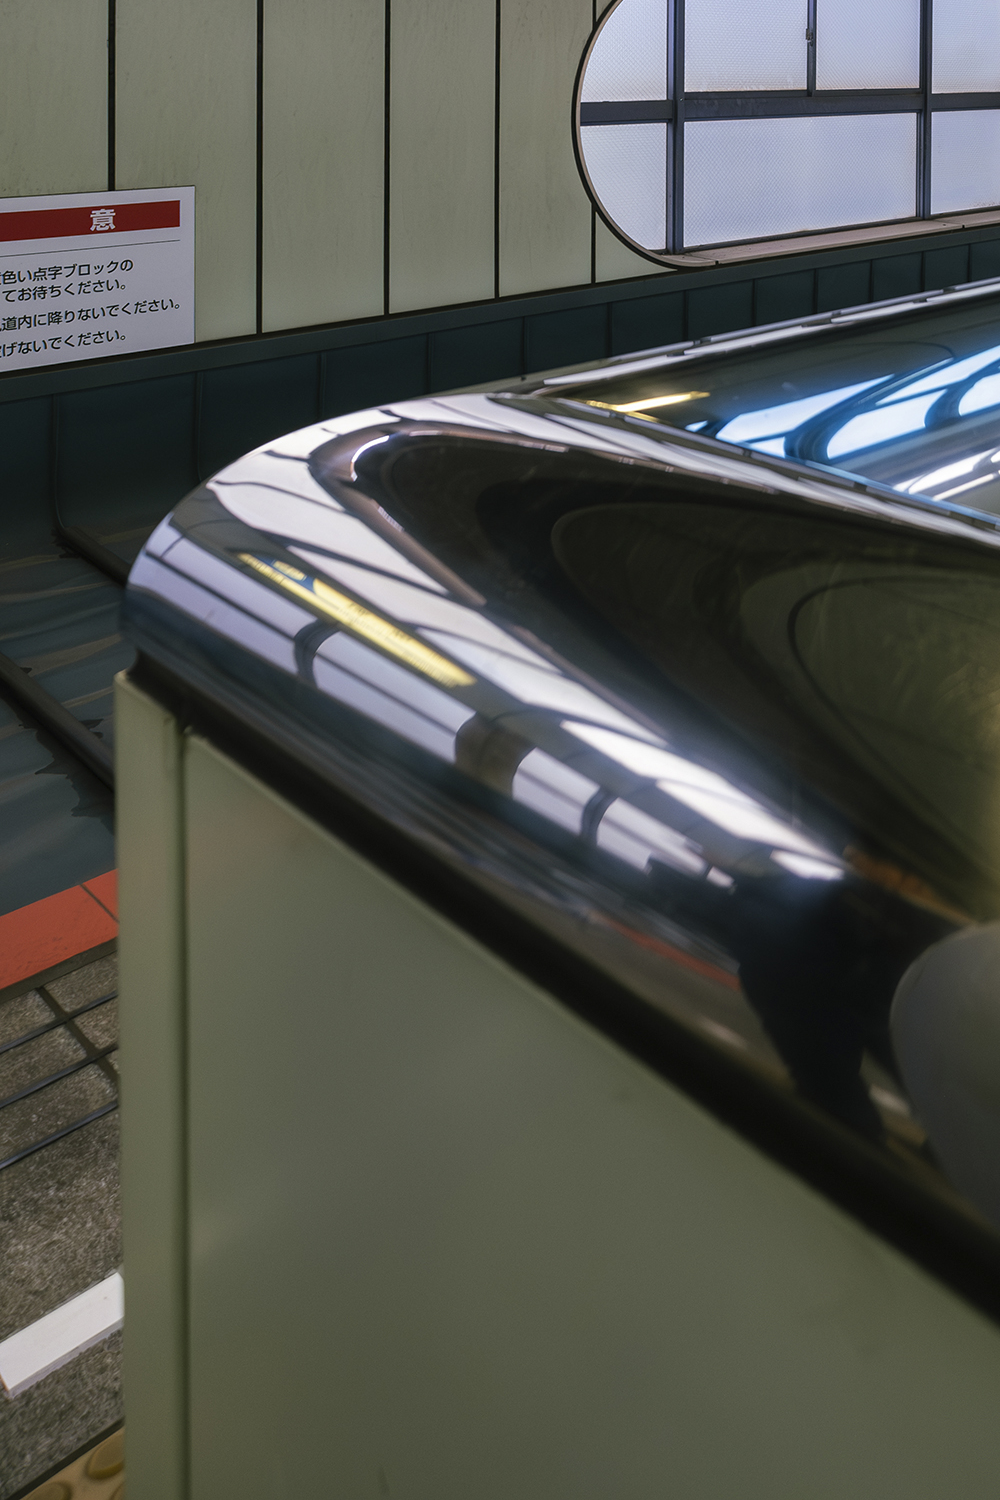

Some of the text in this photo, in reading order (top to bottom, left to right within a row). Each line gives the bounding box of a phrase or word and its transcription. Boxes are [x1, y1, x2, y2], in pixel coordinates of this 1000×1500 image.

[90, 208, 116, 231] 意
[0, 259, 134, 286] 色い点字ブロックの
[2, 278, 126, 303] てお待ちください。
[0, 298, 181, 333] 道内に降りないでください。
[0, 329, 126, 359] げないでください。
